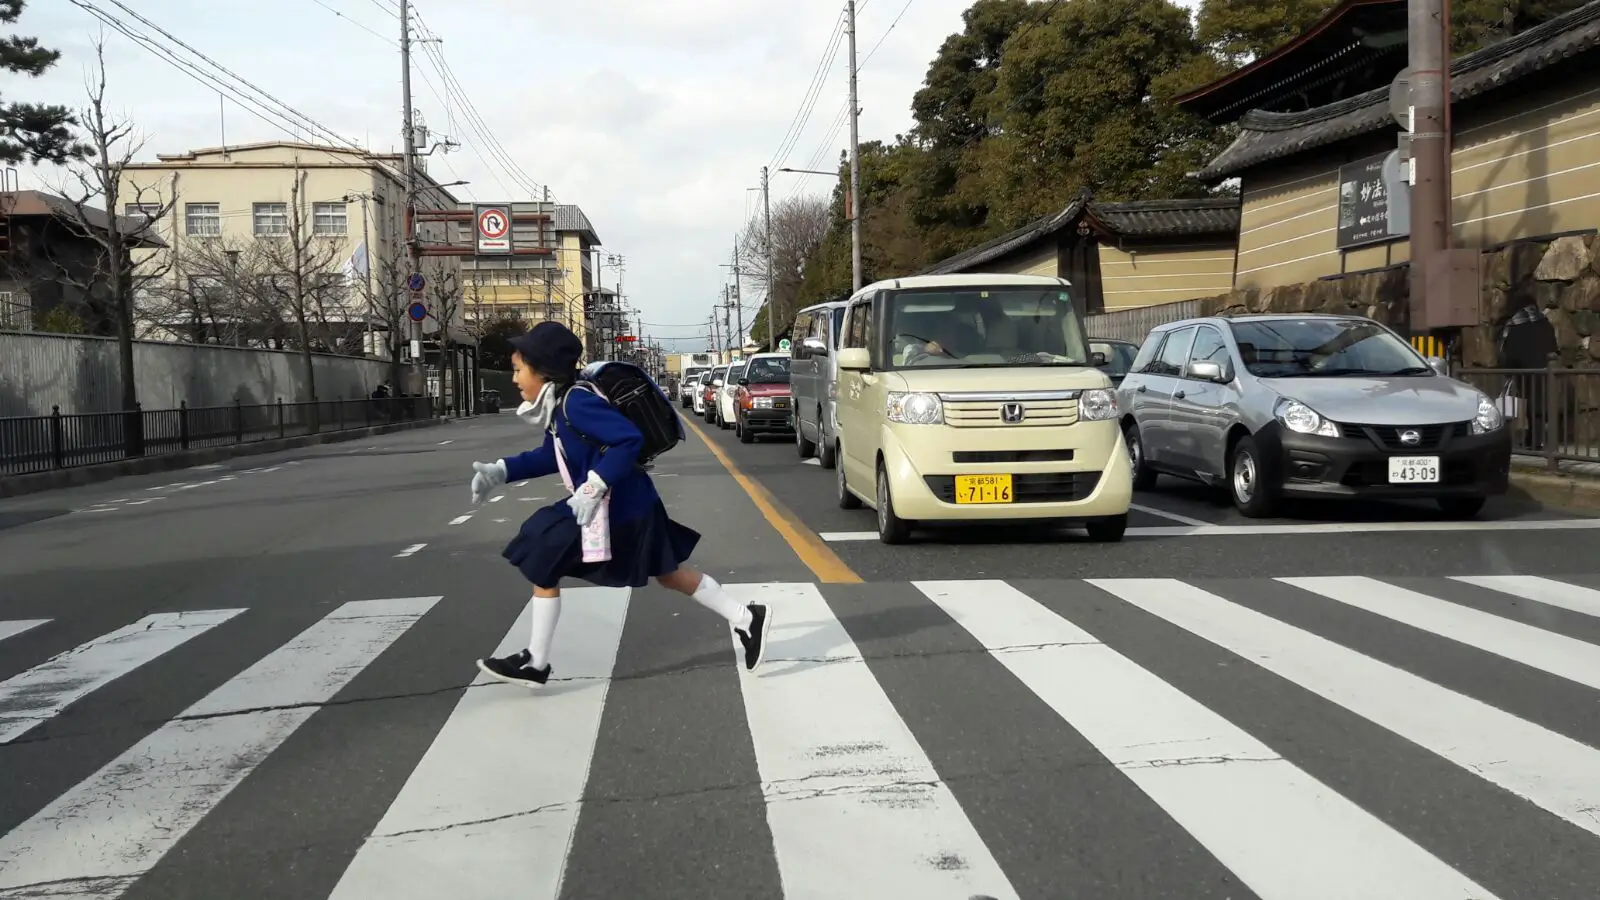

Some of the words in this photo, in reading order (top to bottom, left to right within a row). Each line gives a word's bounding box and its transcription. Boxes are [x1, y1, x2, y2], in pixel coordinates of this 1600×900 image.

[1360, 178, 1388, 202] 妙法
[1400, 467, 1436, 480] 43-09
[968, 486, 1009, 502] 71-16
